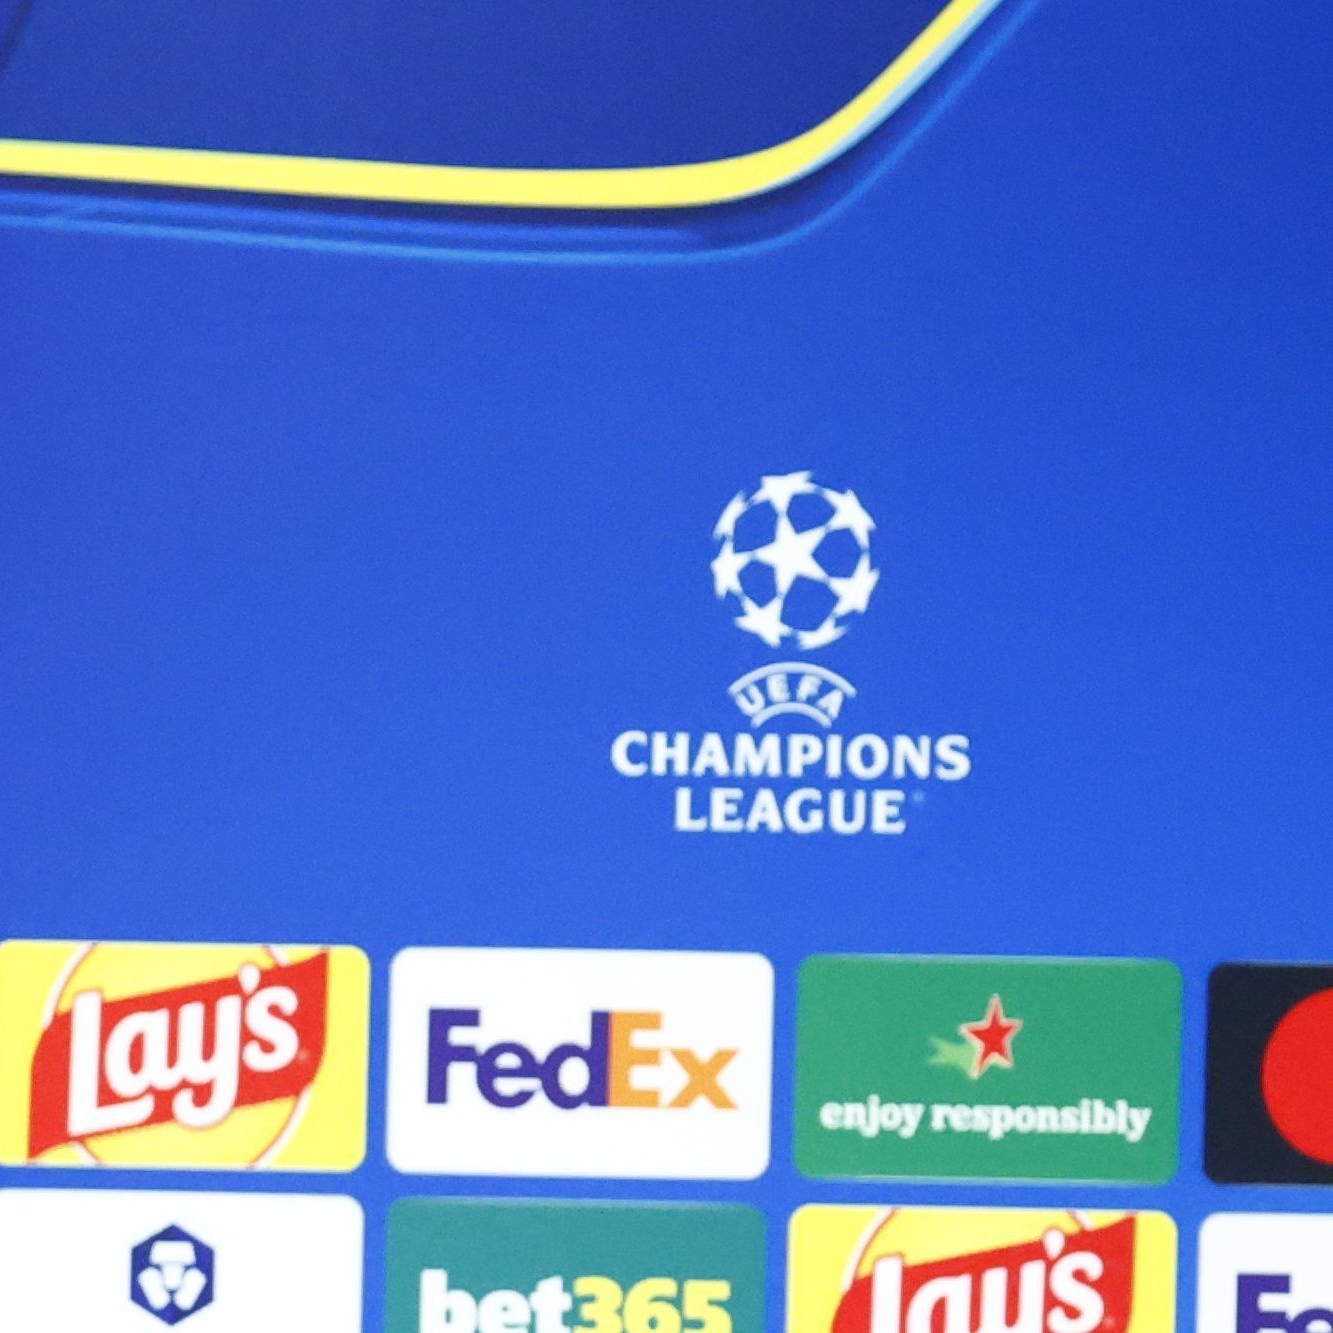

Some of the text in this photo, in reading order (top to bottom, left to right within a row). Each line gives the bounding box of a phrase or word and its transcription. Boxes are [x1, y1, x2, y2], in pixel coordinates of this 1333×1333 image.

[735, 673, 845, 719] UEFA
[611, 730, 971, 780] CHAMPIONS
[675, 787, 905, 834] LEAGUE
[67, 963, 301, 1137] Lay's
[426, 1007, 737, 1110] FedEx
[819, 1094, 1152, 1142] enjoy responsibly
